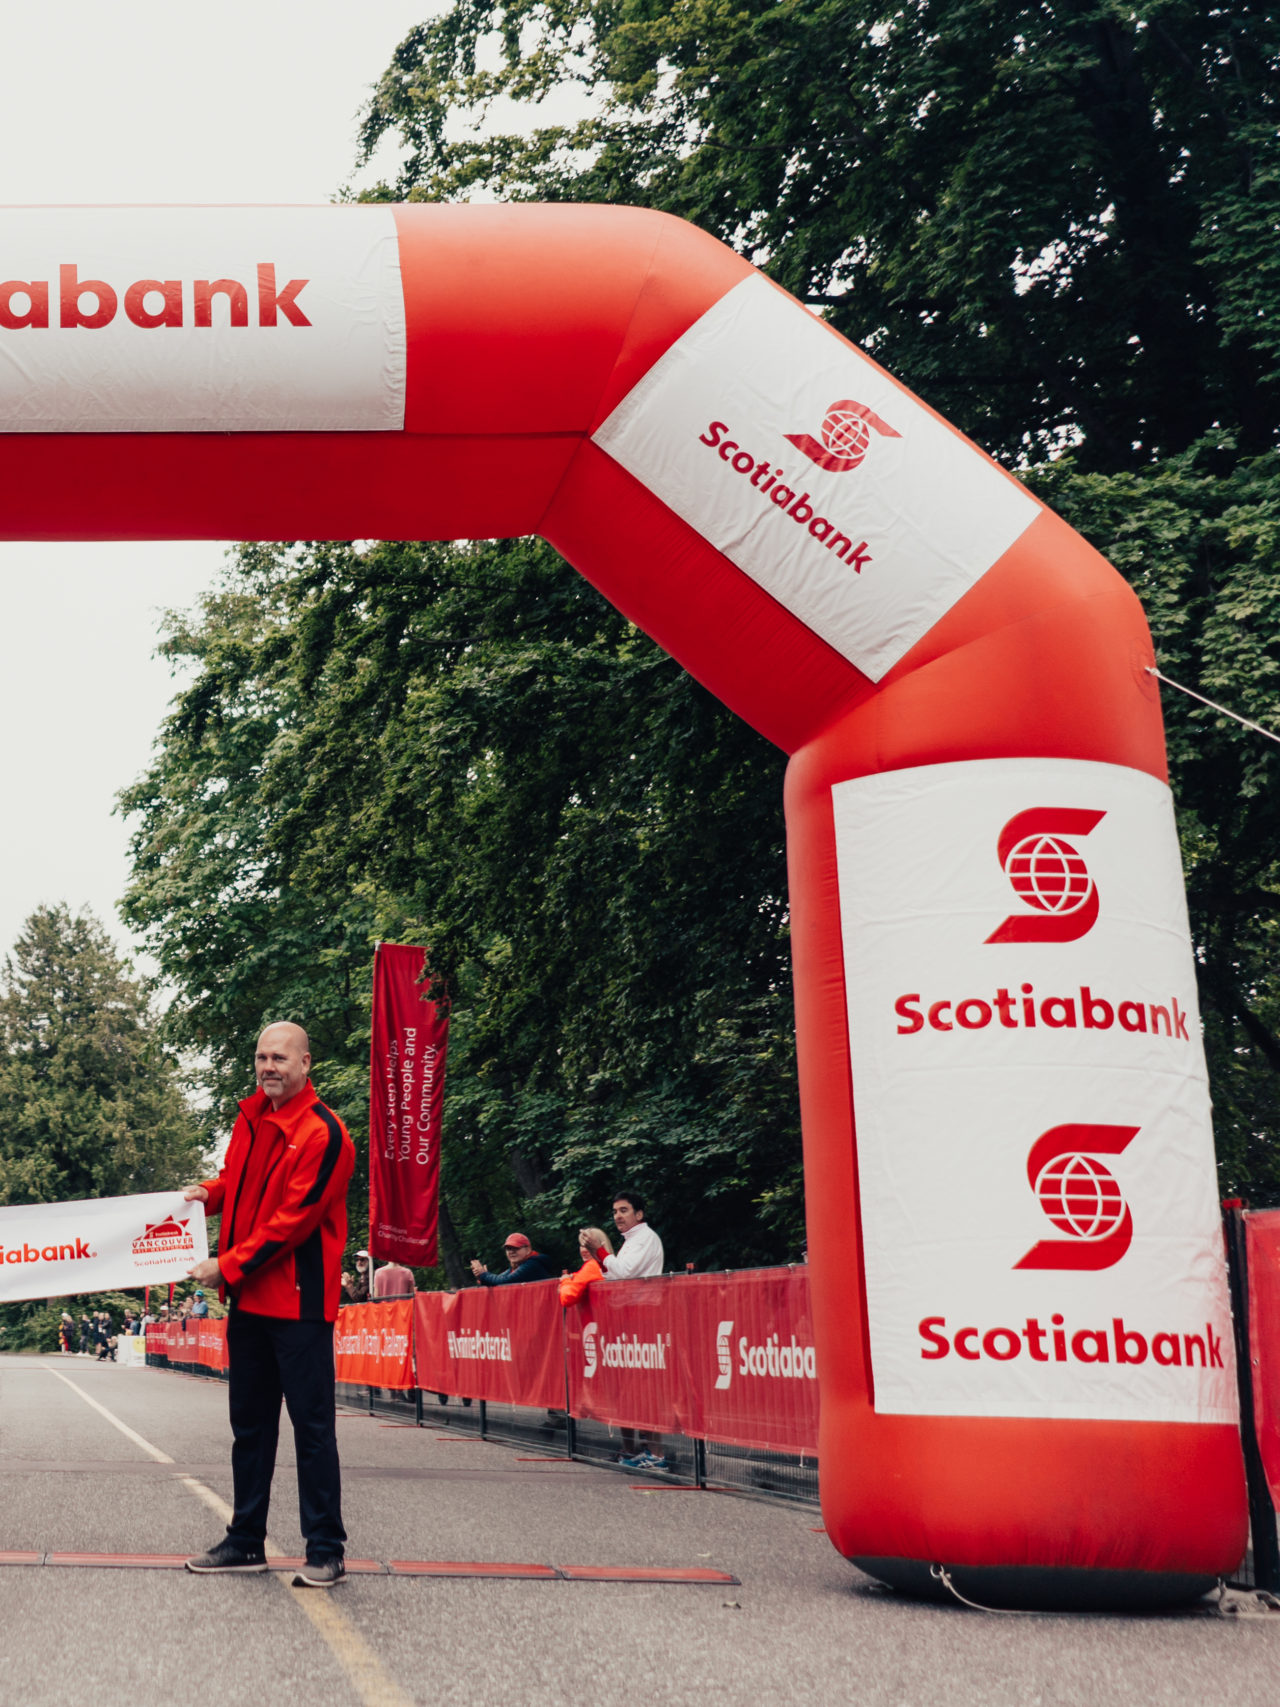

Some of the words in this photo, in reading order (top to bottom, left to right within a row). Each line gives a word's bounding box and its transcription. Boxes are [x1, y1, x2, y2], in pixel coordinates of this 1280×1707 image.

[698, 421, 873, 575] Scotiabank
[894, 982, 1190, 1042] Scotiabank
[386, 1039, 400, 1079] Helps
[403, 1027, 417, 1057] and
[401, 1060, 416, 1111] People
[417, 1043, 439, 1132] Community.
[384, 1121, 397, 1160] Every
[397, 1115, 414, 1163] Young
[416, 1136, 430, 1165] Our
[132, 1237, 194, 1249] VANCOUVER
[600, 1332, 667, 1370] Scotiabank
[739, 1333, 817, 1379] Scotiaba
[917, 1312, 1225, 1369] Scotiabank
